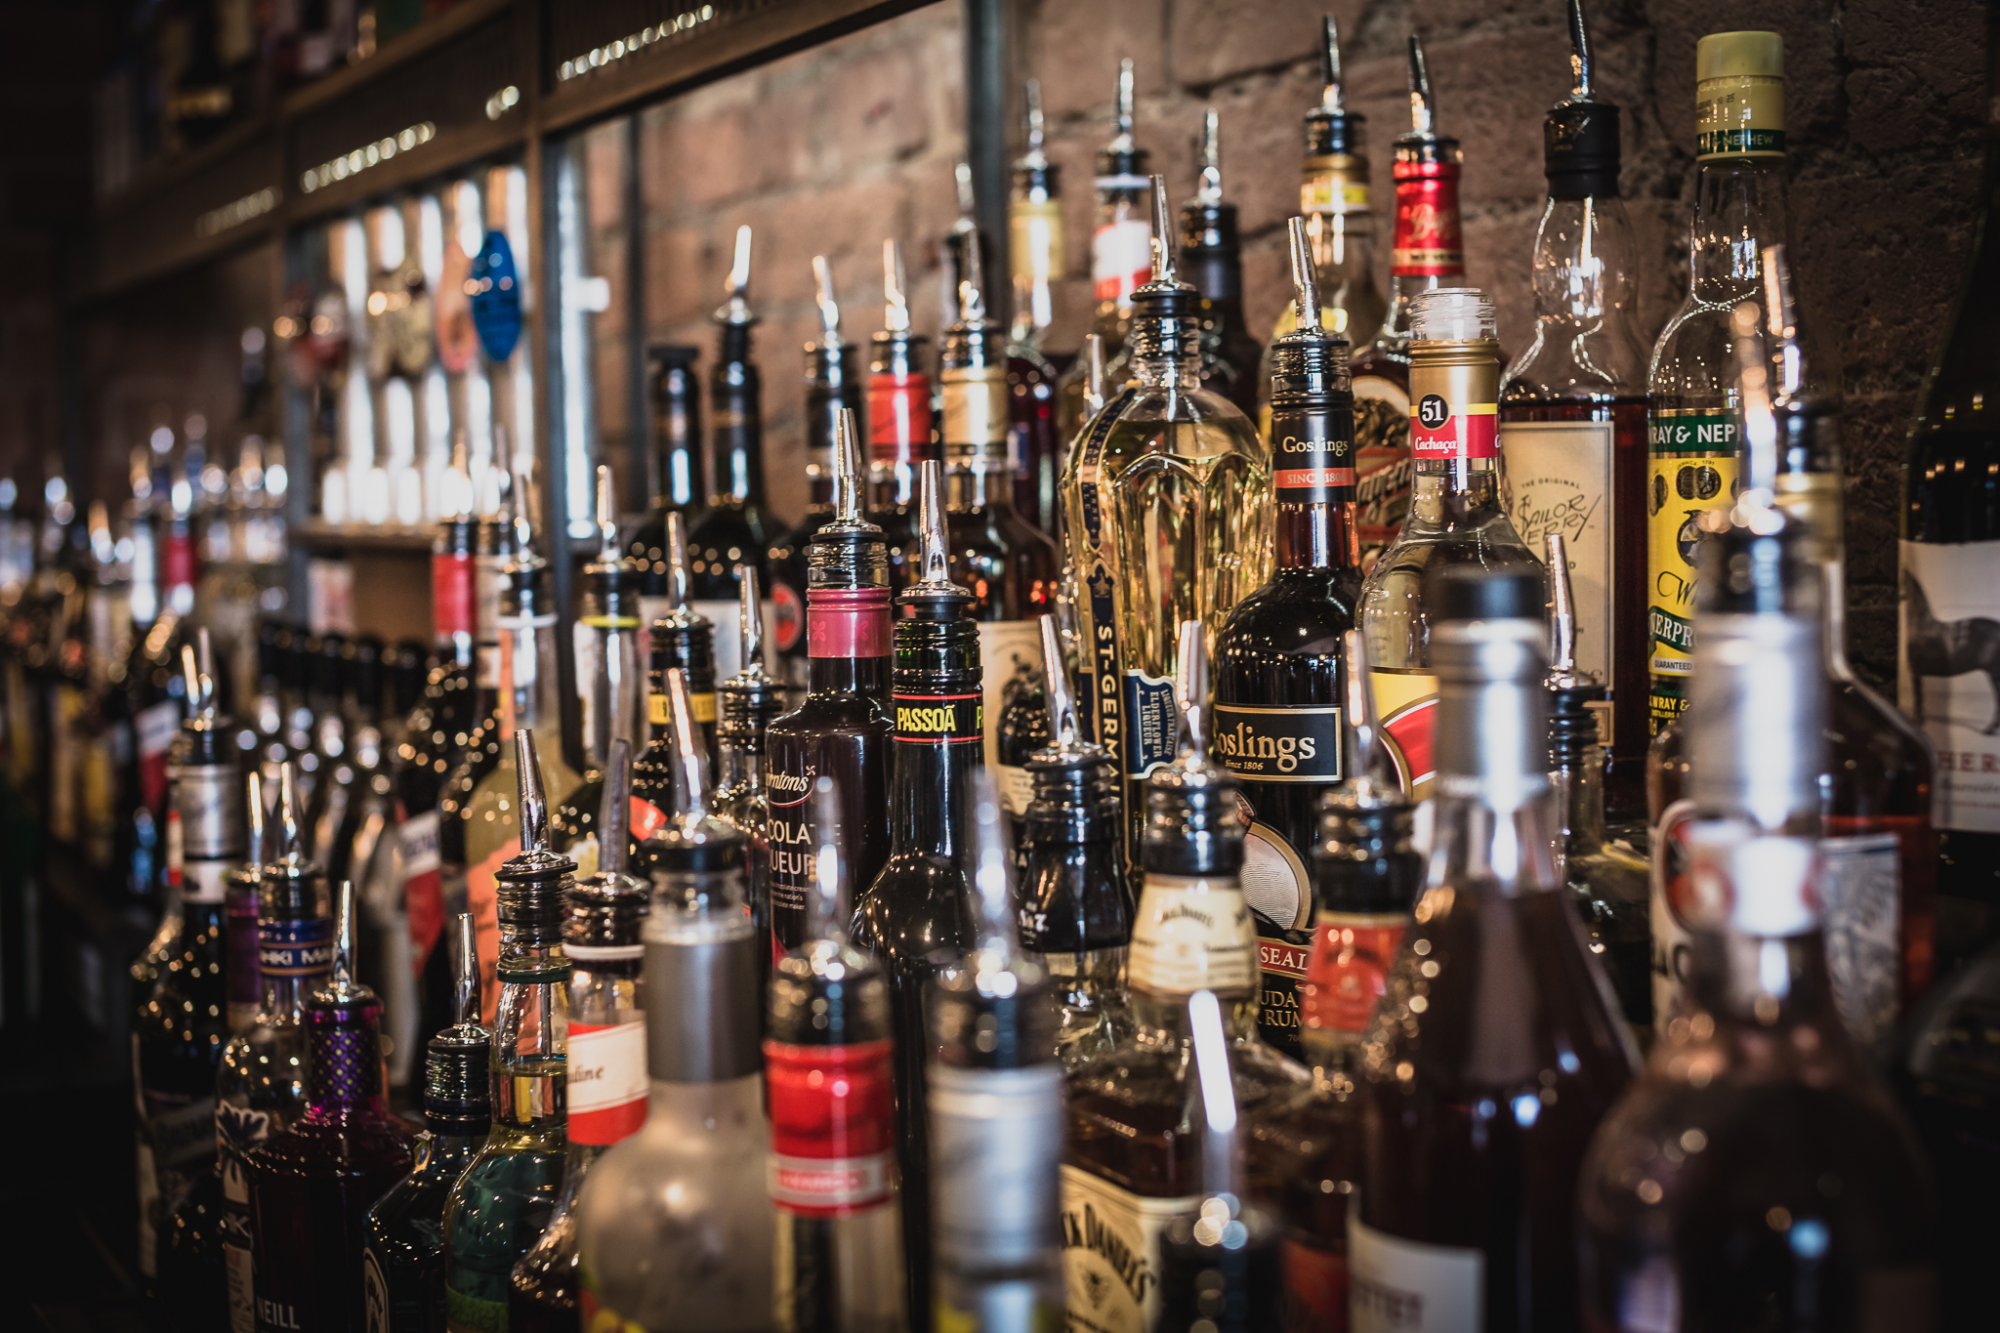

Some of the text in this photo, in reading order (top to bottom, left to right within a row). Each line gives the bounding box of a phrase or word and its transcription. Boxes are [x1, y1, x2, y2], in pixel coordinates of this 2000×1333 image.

[1421, 400, 1445, 422] 51
[1415, 436, 1458, 454] Cachaça
[1675, 425, 1691, 444] &
[1282, 435, 1349, 457] Goslings
[1521, 478, 1581, 489] THE ORIGINAL
[897, 704, 957, 732] PASSOÃ
[1141, 705, 1153, 746] LIQUEUR
[1149, 691, 1162, 758] ELDERFLOWER
[1225, 760, 1264, 770] Since 1806
[1260, 946, 1309, 971] SEAL
